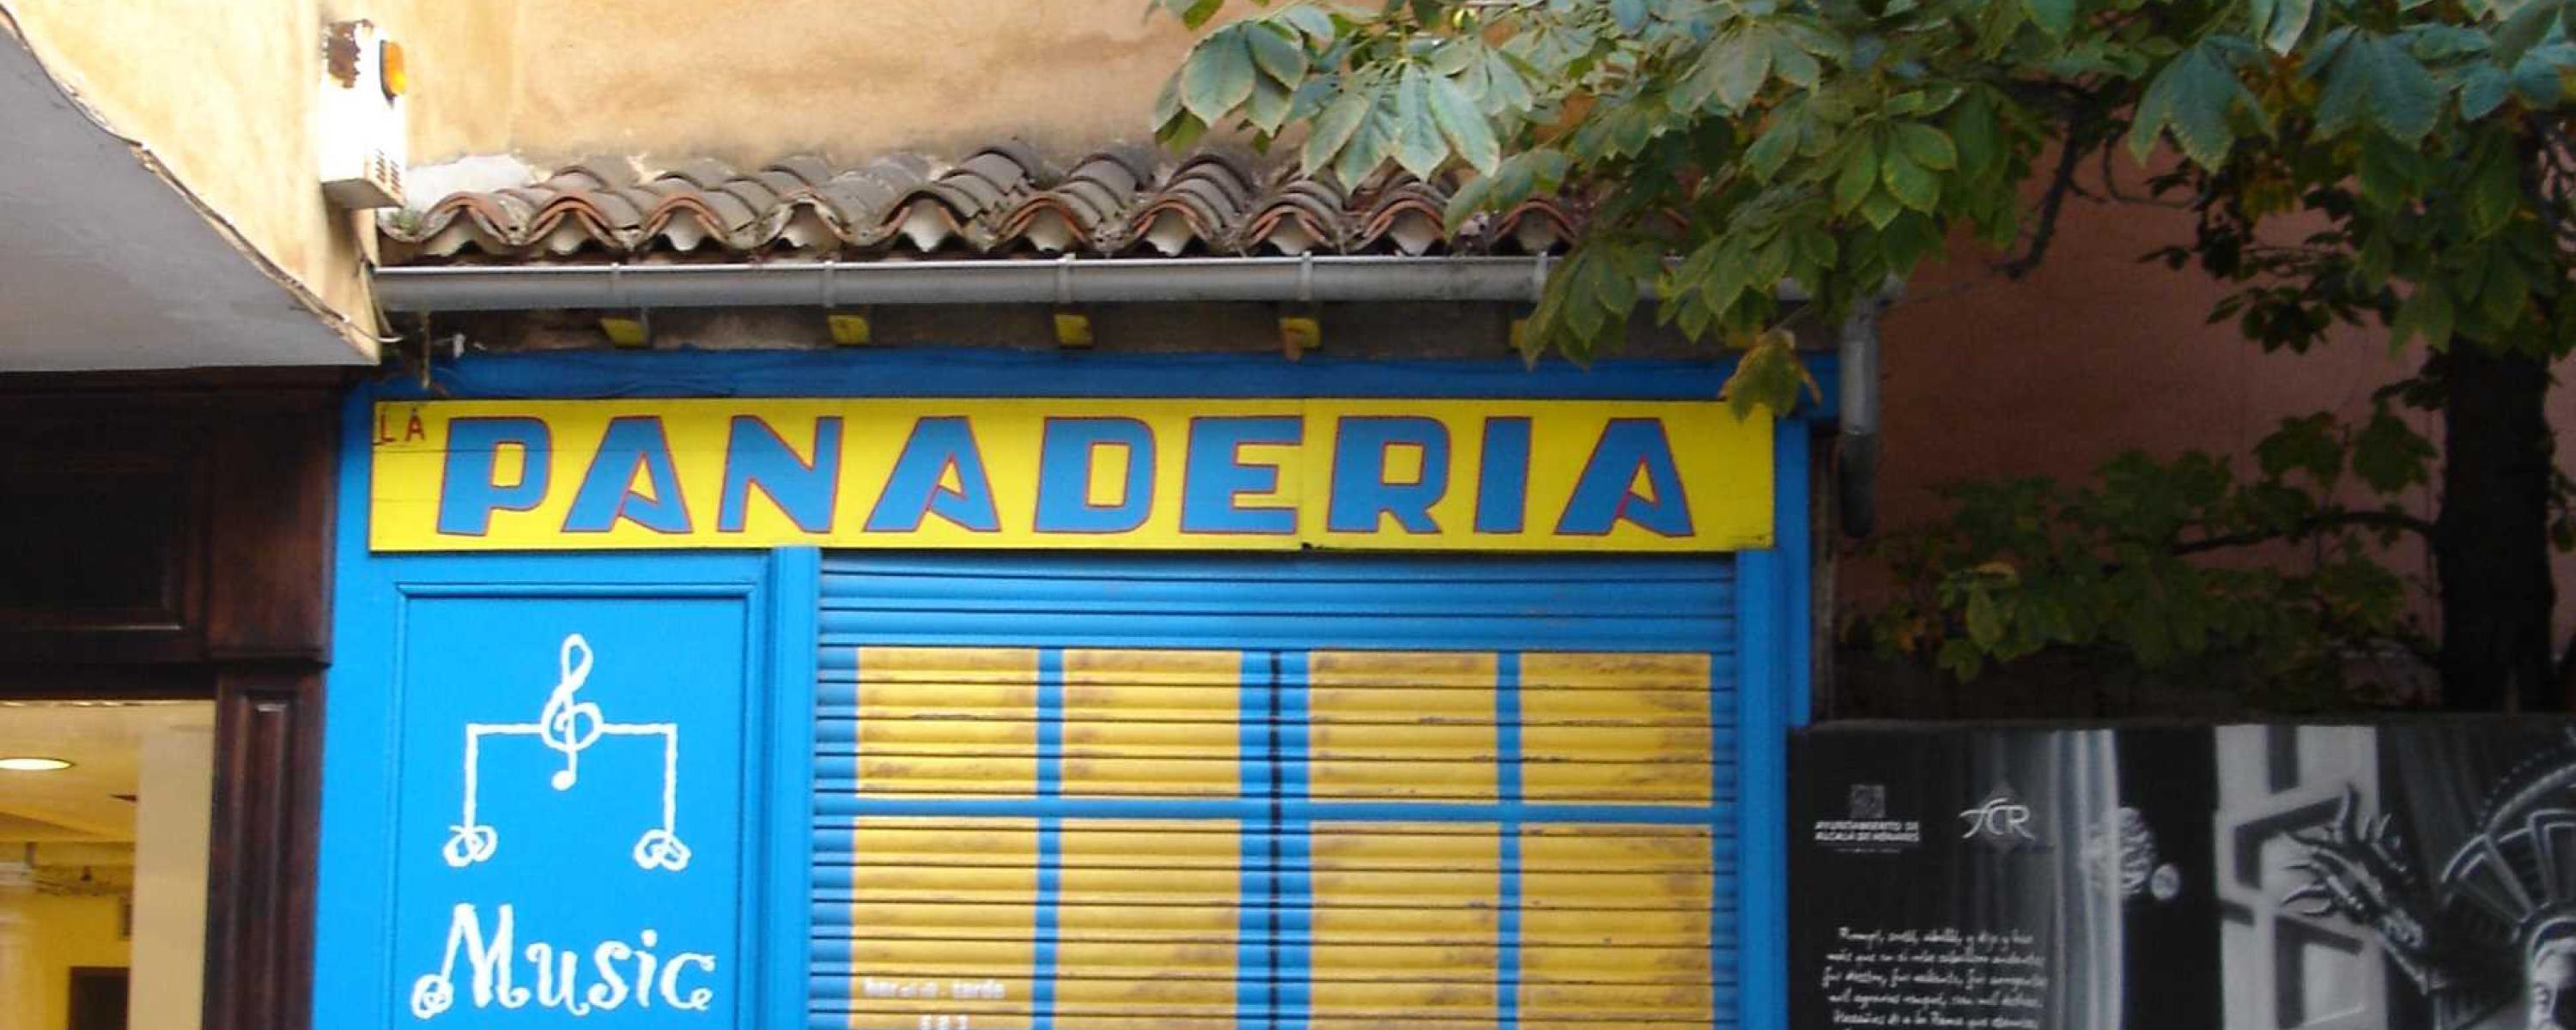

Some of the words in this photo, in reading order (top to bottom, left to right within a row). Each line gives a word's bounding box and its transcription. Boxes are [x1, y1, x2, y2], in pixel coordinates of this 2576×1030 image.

[380, 414, 426, 441] LA
[436, 415, 1694, 537] PANADERIA
[410, 902, 716, 1020] Music
